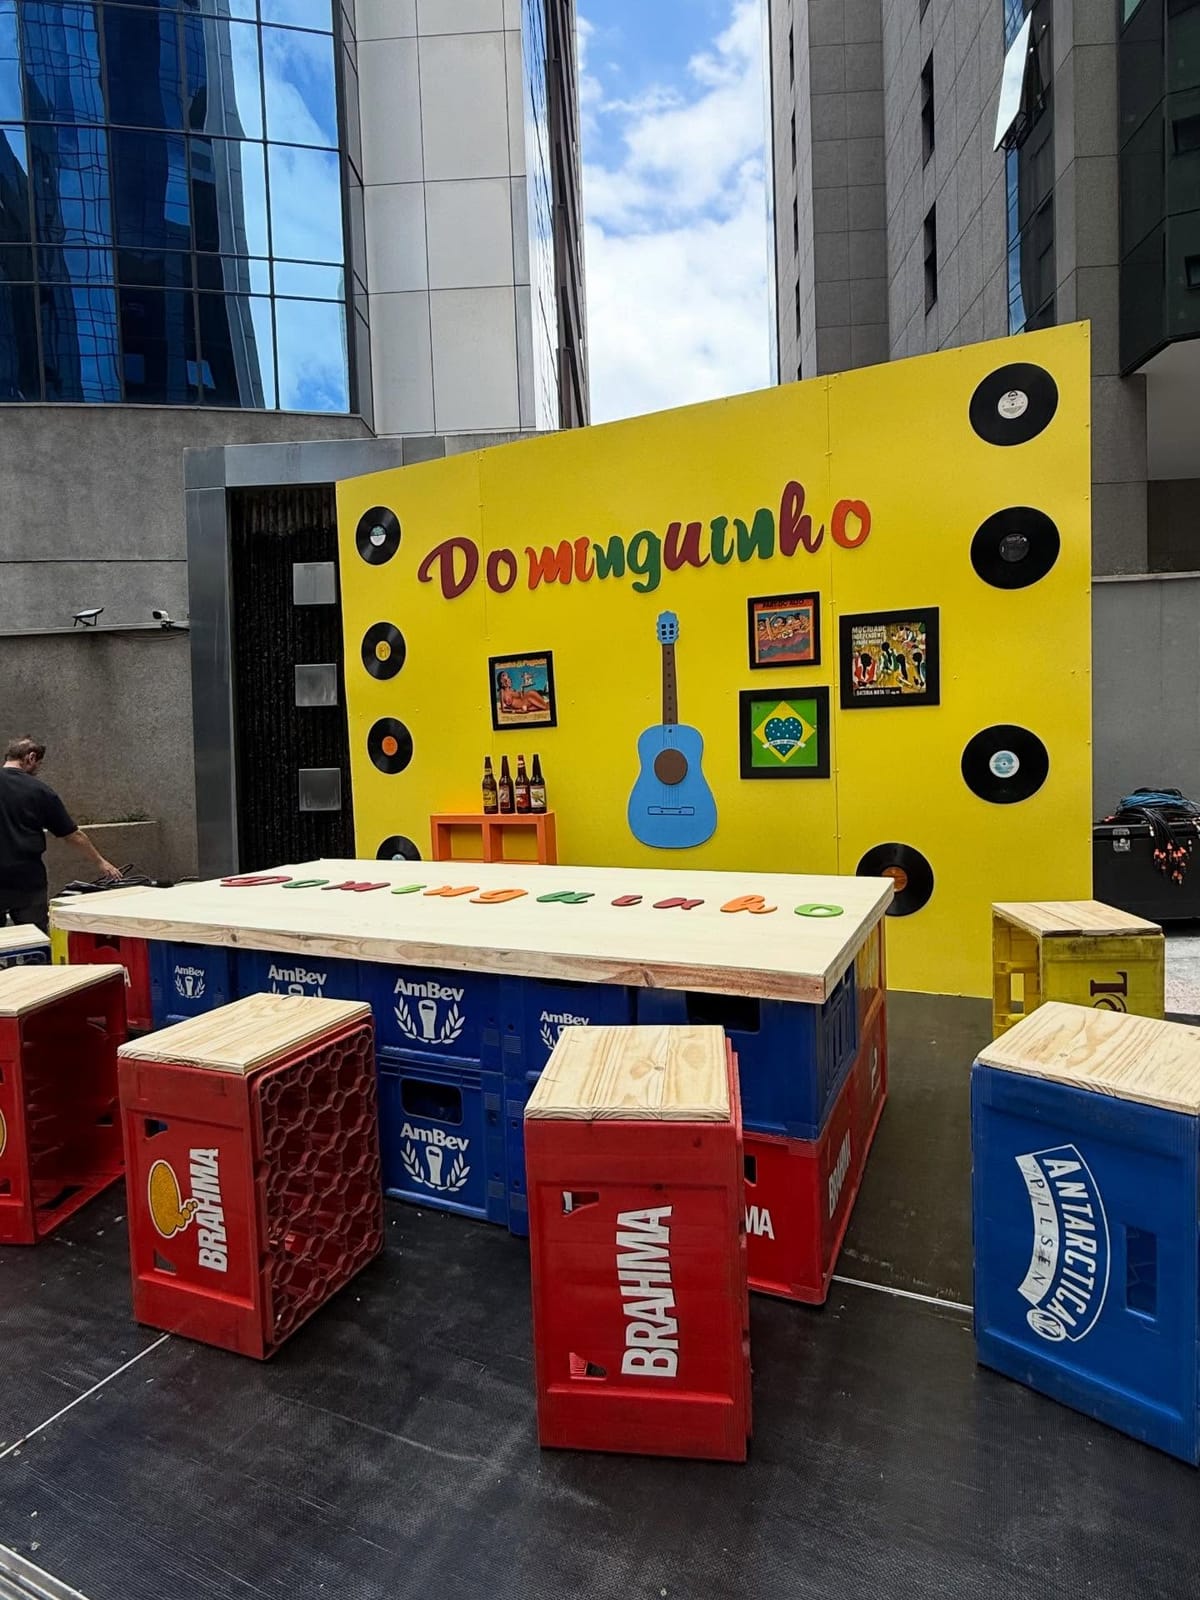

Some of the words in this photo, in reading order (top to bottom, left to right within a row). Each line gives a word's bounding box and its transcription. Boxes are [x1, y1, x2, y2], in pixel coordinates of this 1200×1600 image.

[417, 481, 872, 600] Dominguinho
[174, 965, 205, 977] AmBev
[268, 964, 327, 985] AmBev
[394, 978, 465, 1002] AmBev
[539, 1011, 590, 1026] AmBev
[400, 1123, 469, 1151] AmBev
[189, 1148, 228, 1273] BRAHMA
[1030, 1178, 1054, 1286] PILSEN
[1042, 1158, 1097, 1327] ANTARCTICA
[616, 1205, 680, 1377] BRAHMA
